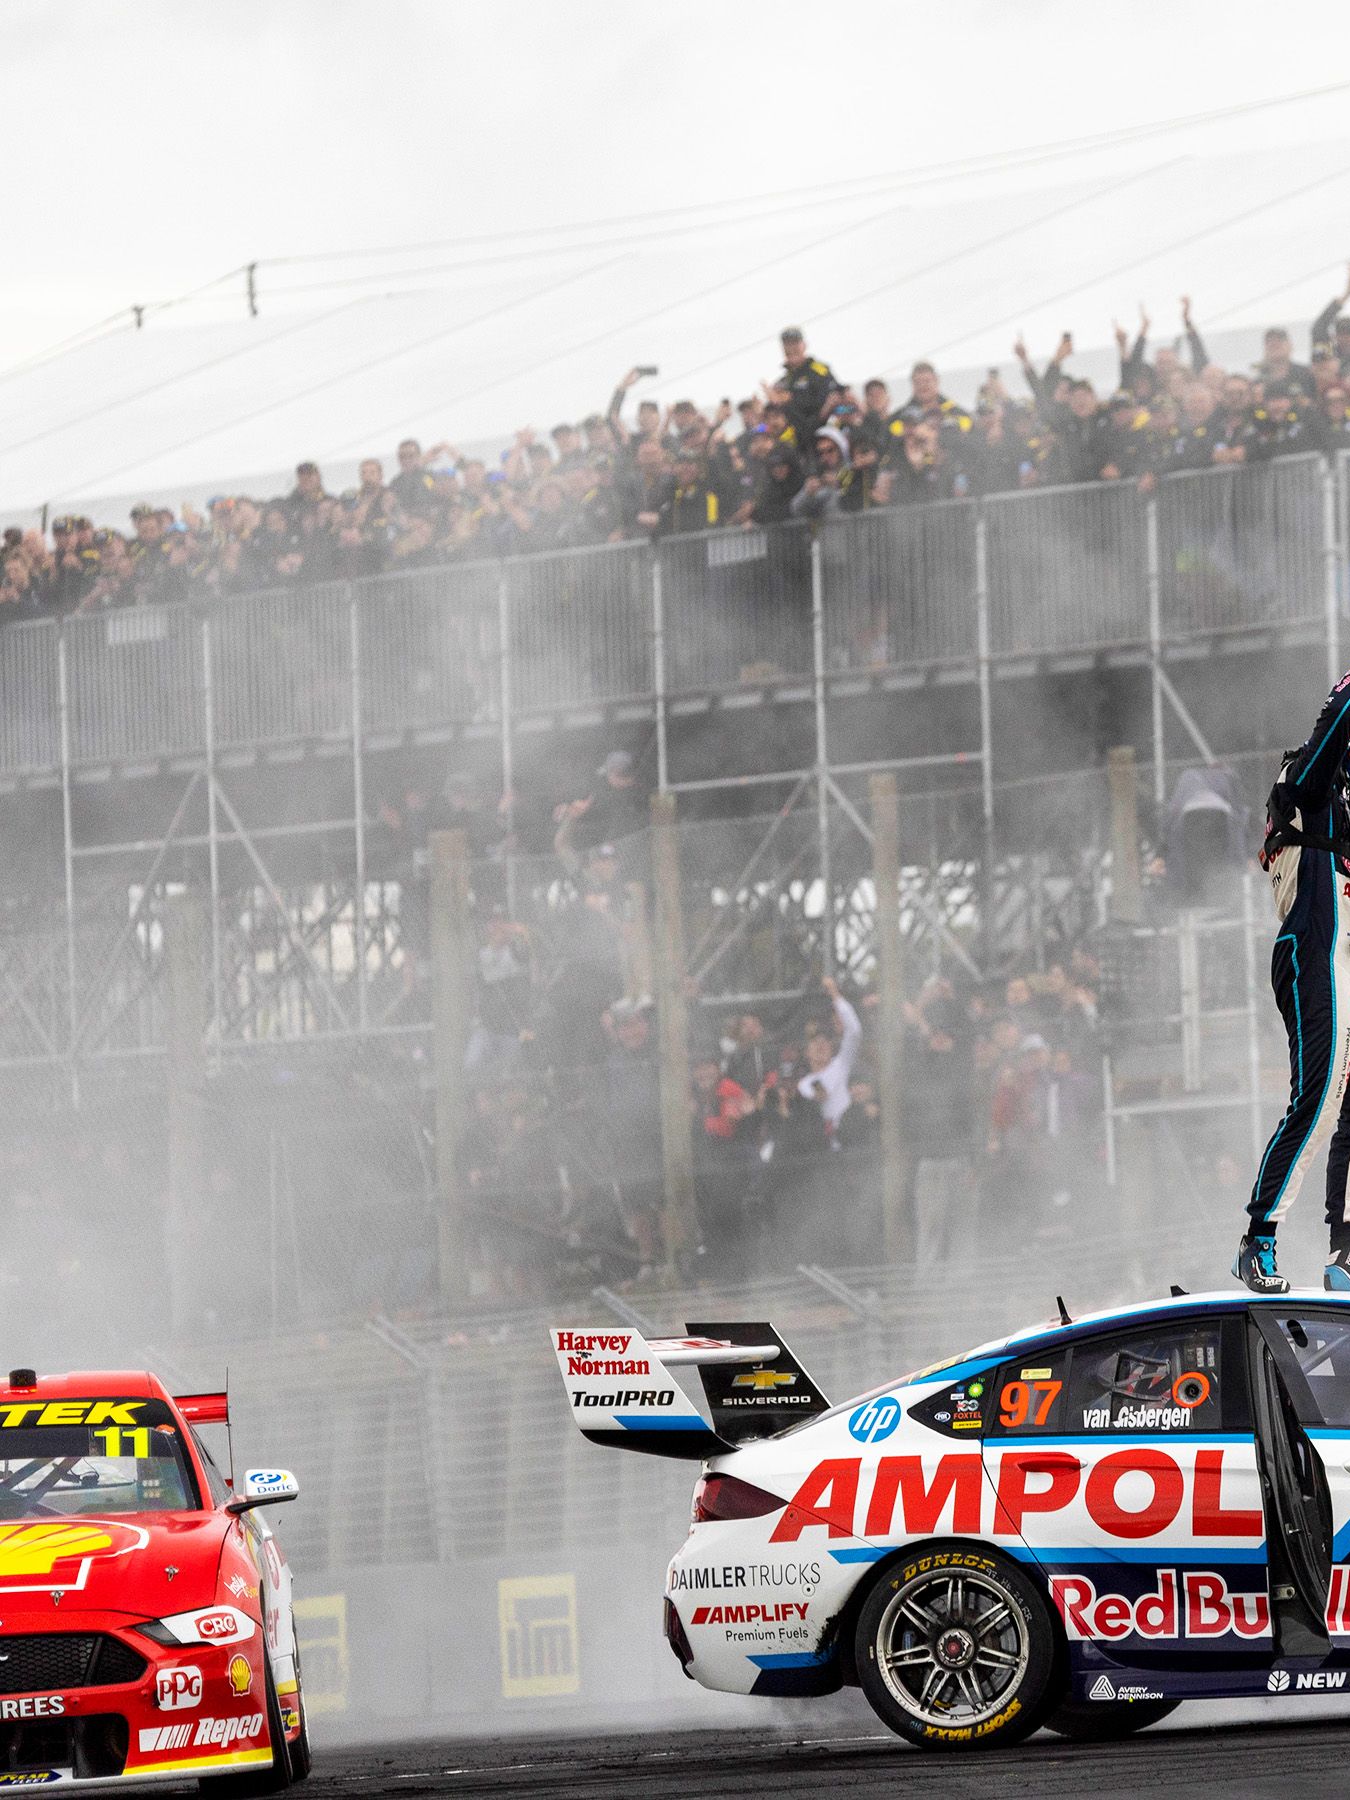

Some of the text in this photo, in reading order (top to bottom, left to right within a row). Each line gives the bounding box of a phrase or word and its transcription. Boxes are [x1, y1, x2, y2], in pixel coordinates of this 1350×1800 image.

[557, 1332, 632, 1355] Harvey
[567, 1357, 650, 1376] Norman
[572, 1390, 675, 1407] ToolPRO
[722, 1395, 811, 1406] SILVERADO
[999, 1380, 1063, 1428] 97
[0, 1401, 147, 1428] TEK
[852, 1399, 898, 1443] hp
[953, 1411, 982, 1420] FOXTEL
[1083, 1406, 1191, 1430] van Gisbergen
[94, 1426, 149, 1459] 11
[257, 1484, 293, 1493] Doric
[769, 1449, 1263, 1543] AMPOL
[671, 1562, 821, 1590] DAIMLER TRUCKS
[904, 1553, 995, 1581] DUNLOP
[708, 1603, 809, 1624] AMPLIFY
[1050, 1569, 1178, 1640] Red
[199, 1615, 236, 1636] CRC
[726, 1627, 809, 1642] Premium Fuels
[159, 1671, 201, 1706] PPG
[1296, 1670, 1347, 1689] NEW
[0, 1695, 65, 1719] REES
[193, 1713, 264, 1748] Repco
